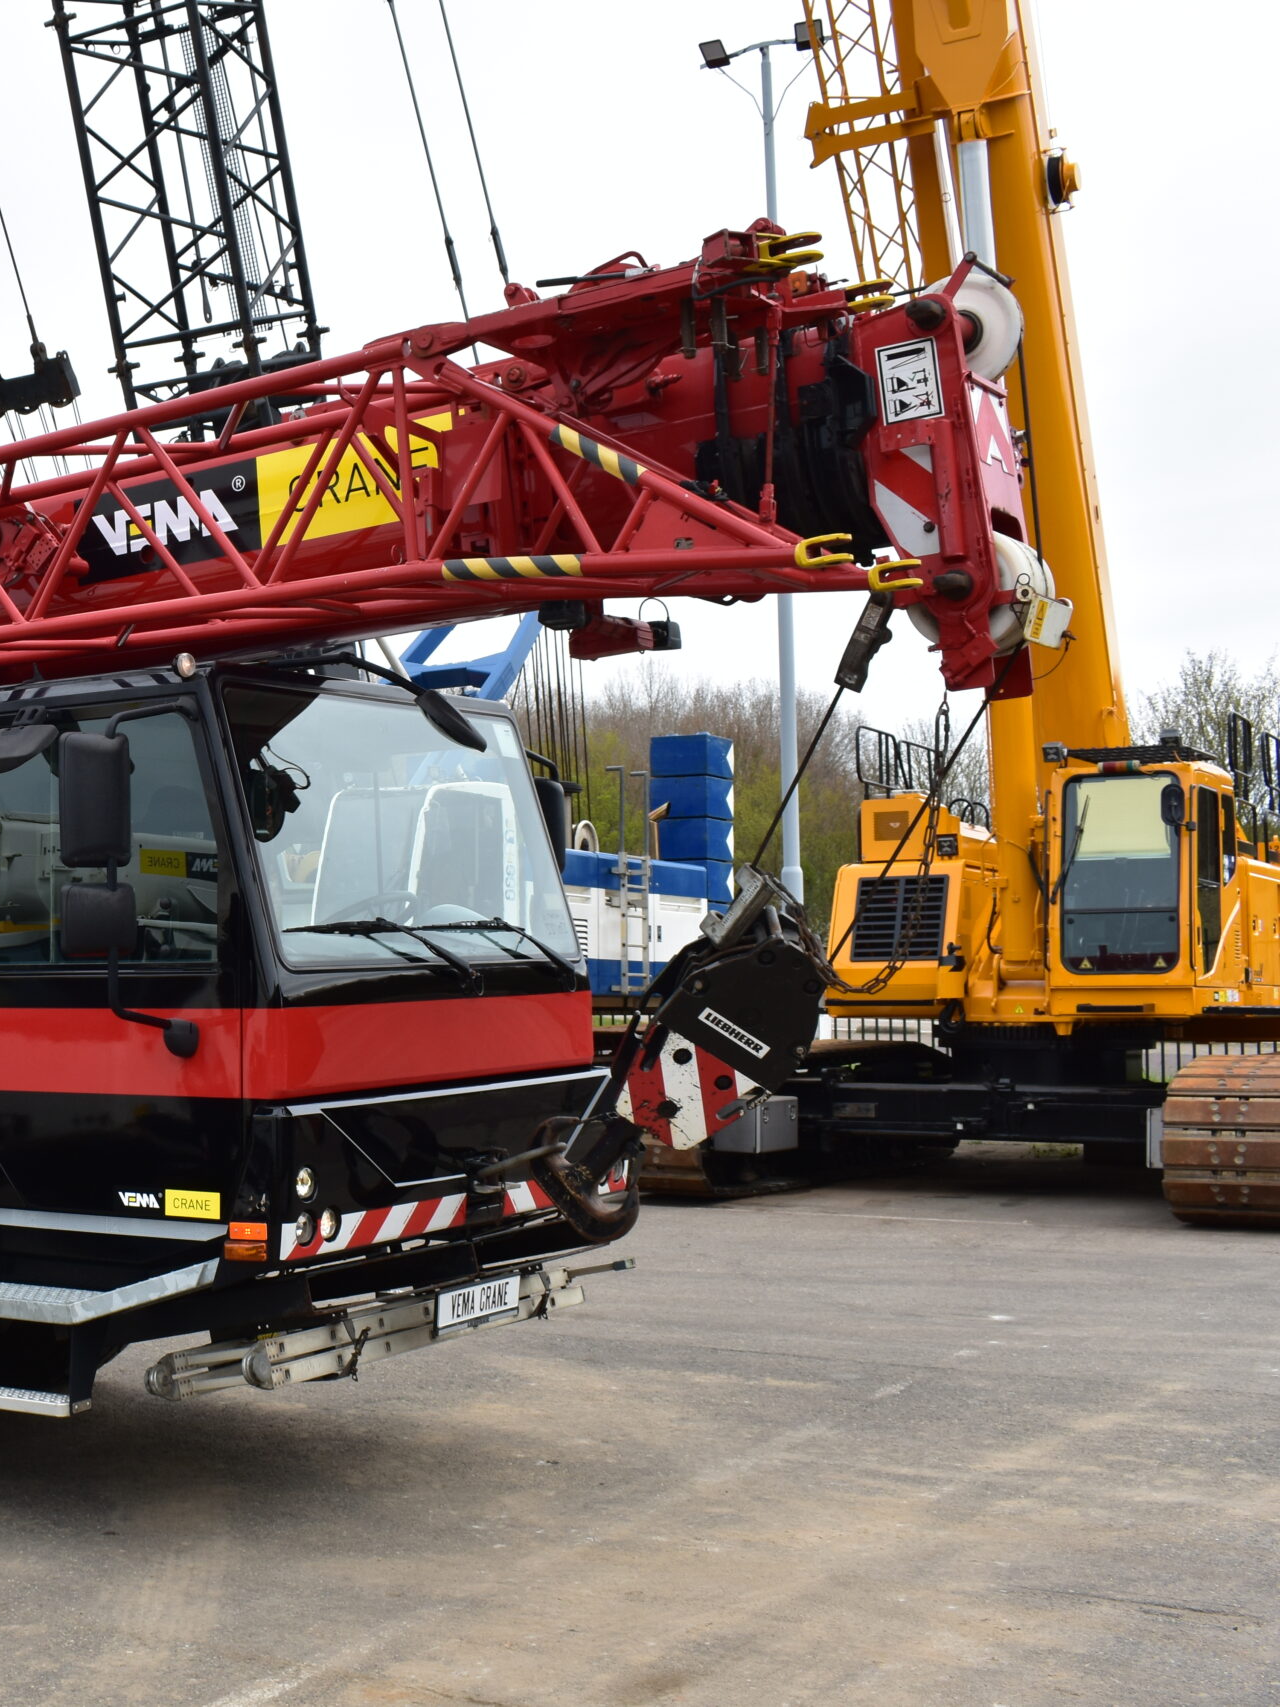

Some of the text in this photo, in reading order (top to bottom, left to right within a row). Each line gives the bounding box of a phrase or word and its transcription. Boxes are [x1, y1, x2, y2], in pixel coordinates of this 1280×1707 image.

[92, 489, 239, 555] VEMA
[704, 1012, 763, 1054] LIEBHERR
[118, 1191, 211, 1211] VEMA CRANE
[451, 1282, 509, 1319] VEMA CRANE
